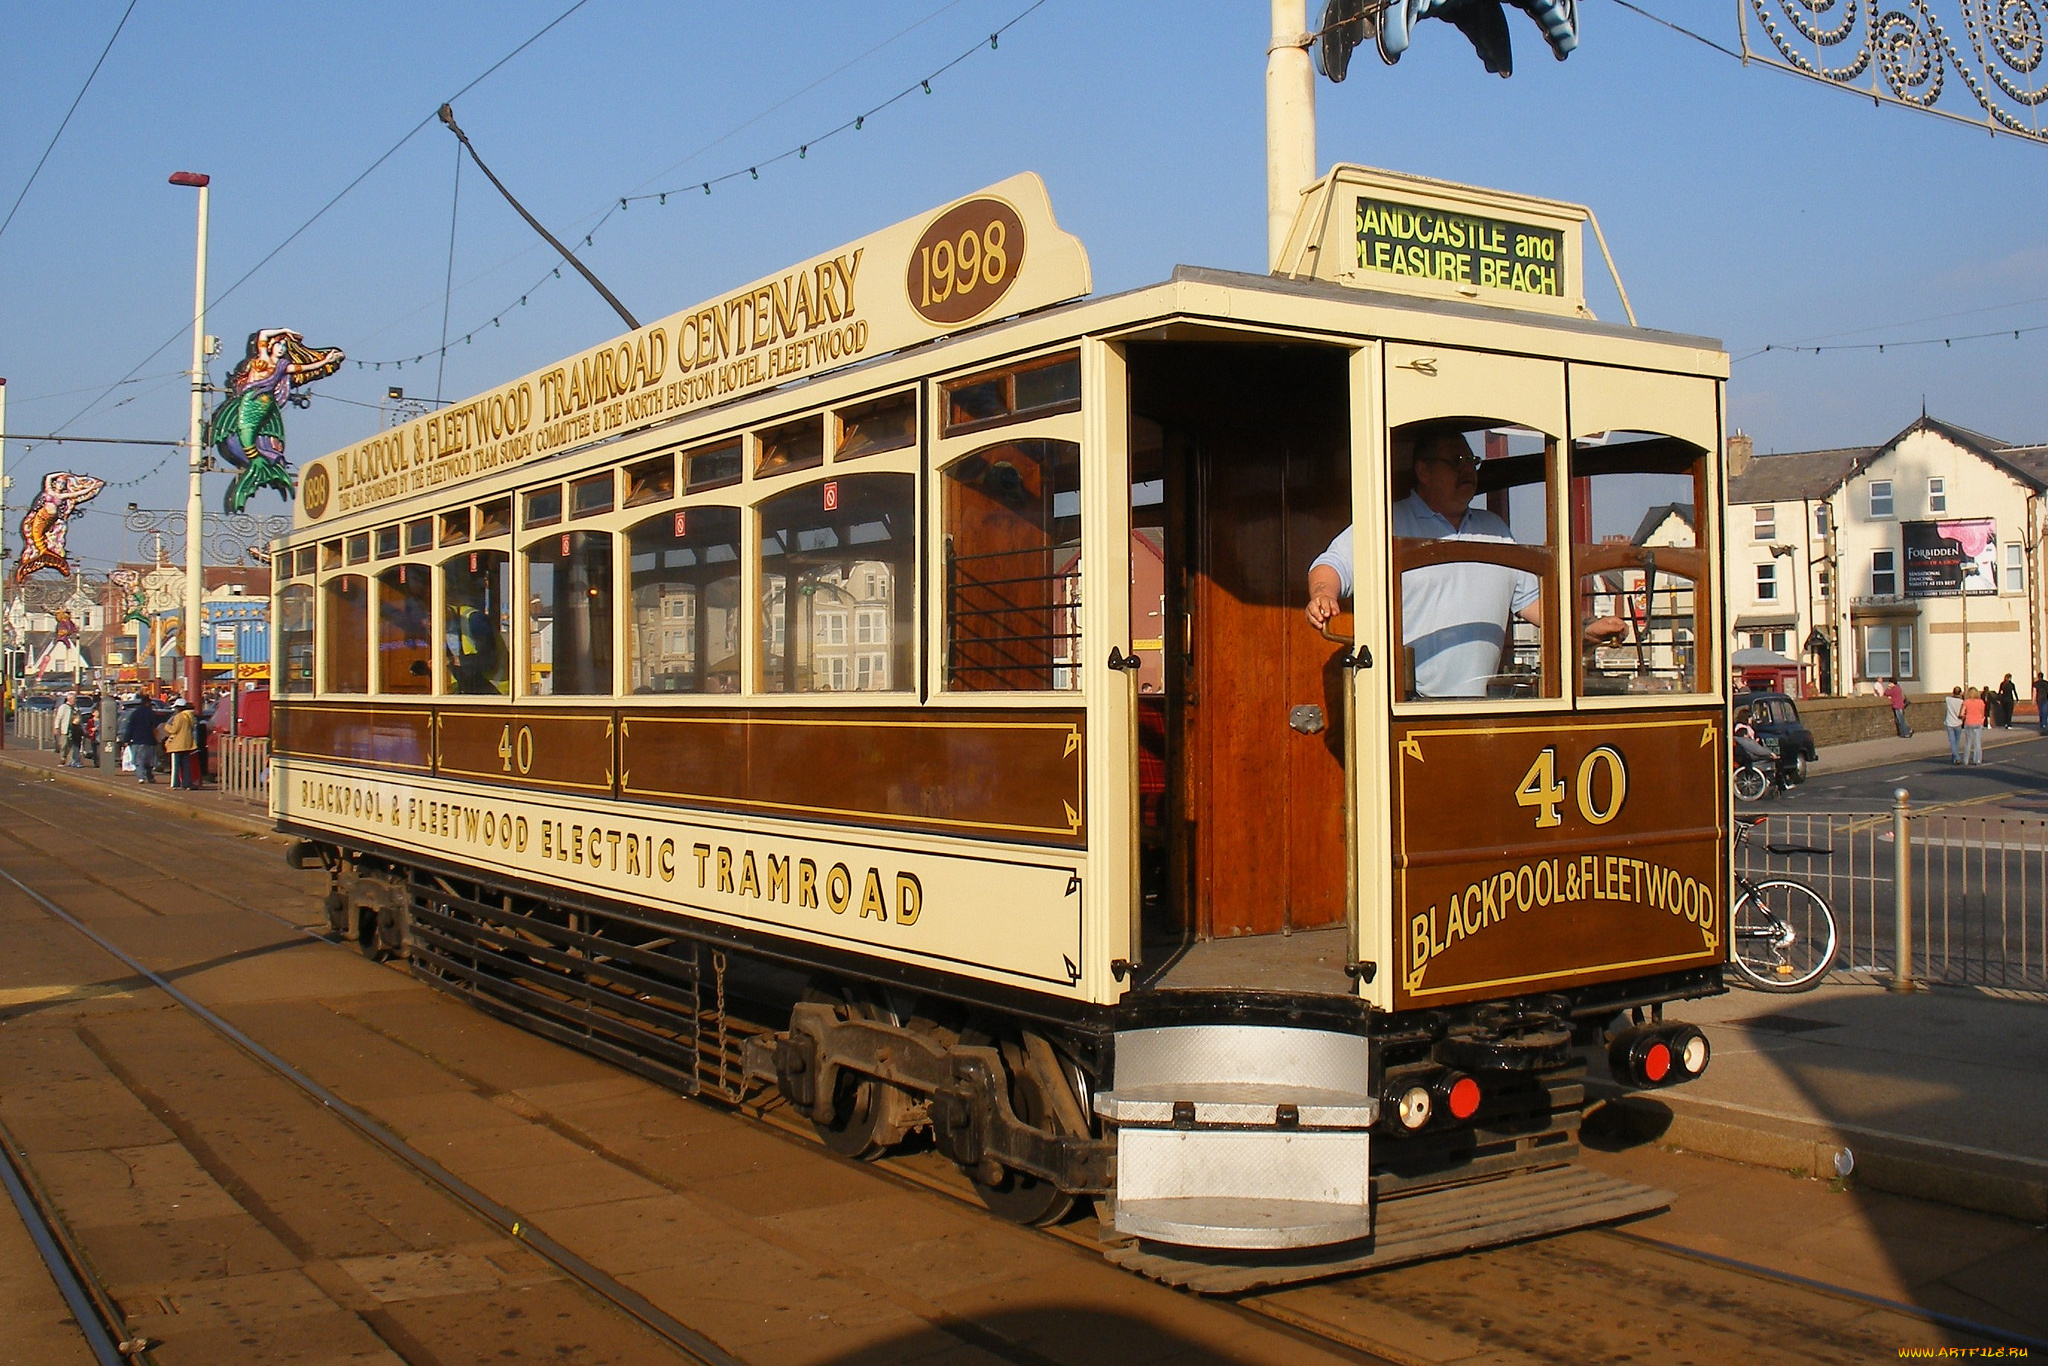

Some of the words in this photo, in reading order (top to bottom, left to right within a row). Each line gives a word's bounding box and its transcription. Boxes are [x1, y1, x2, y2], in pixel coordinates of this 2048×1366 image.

[920, 219, 1007, 308] 1998
[1480, 257, 1557, 296] BEACH
[1515, 233, 1555, 262] and
[337, 430, 409, 491] BLACKPOOL
[413, 424, 425, 466] &
[427, 382, 532, 462] FLEETWOOD
[540, 327, 668, 422] TRAMROAD
[677, 247, 865, 373] CENTENARY
[365, 476, 398, 503] SPONSORED
[399, 472, 409, 494] BY
[410, 467, 424, 490] THE
[426, 452, 471, 486] FLEETWOOD
[474, 444, 498, 473] TRAM
[500, 431, 534, 464] SUNDAY
[536, 412, 590, 452] COMMITTEE
[593, 409, 600, 434] &
[603, 402, 622, 431] THE
[626, 388, 664, 424] NORTH
[666, 369, 716, 410] EUSTON
[718, 354, 765, 395] HOTEL,
[768, 319, 869, 379] FLEETWOOD
[498, 723, 533, 775] 40
[1514, 745, 1628, 828] 40
[301, 780, 383, 823] BLACKPOOL
[390, 795, 400, 827] &
[408, 798, 529, 854] FLEETWOOD
[540, 819, 675, 883] ELECTRIC
[693, 842, 923, 927] TRAMROAD
